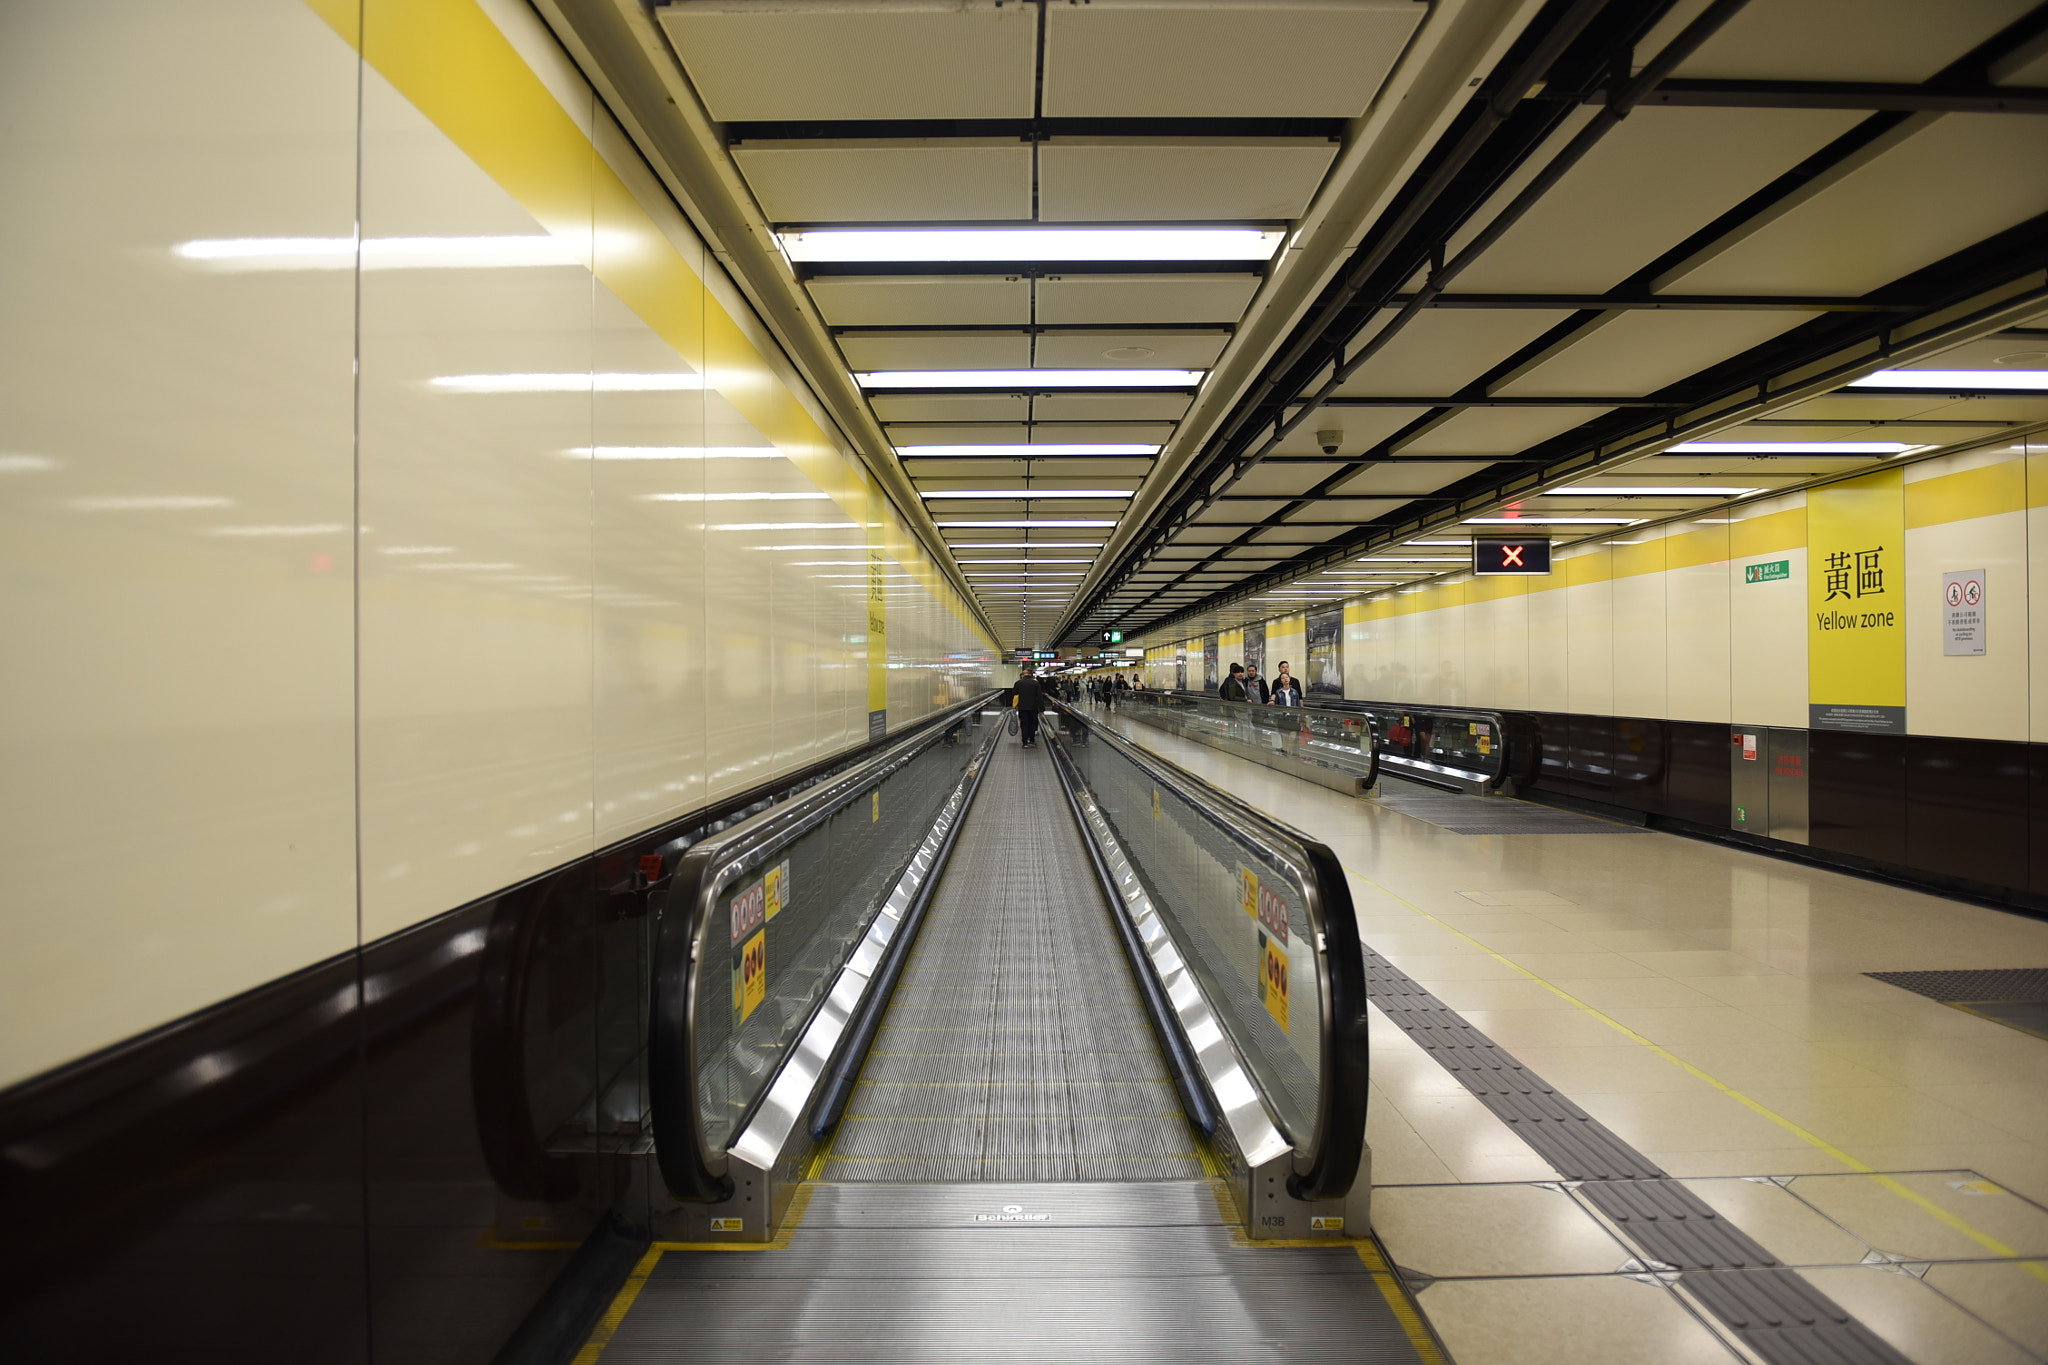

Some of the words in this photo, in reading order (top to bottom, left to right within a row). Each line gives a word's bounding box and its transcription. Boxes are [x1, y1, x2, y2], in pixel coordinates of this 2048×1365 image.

[1824, 545, 1885, 602] 黃區
[1816, 611, 1858, 631] Yellow
[1861, 611, 1895, 629] zone
[1261, 1216, 1285, 1227] M3B
